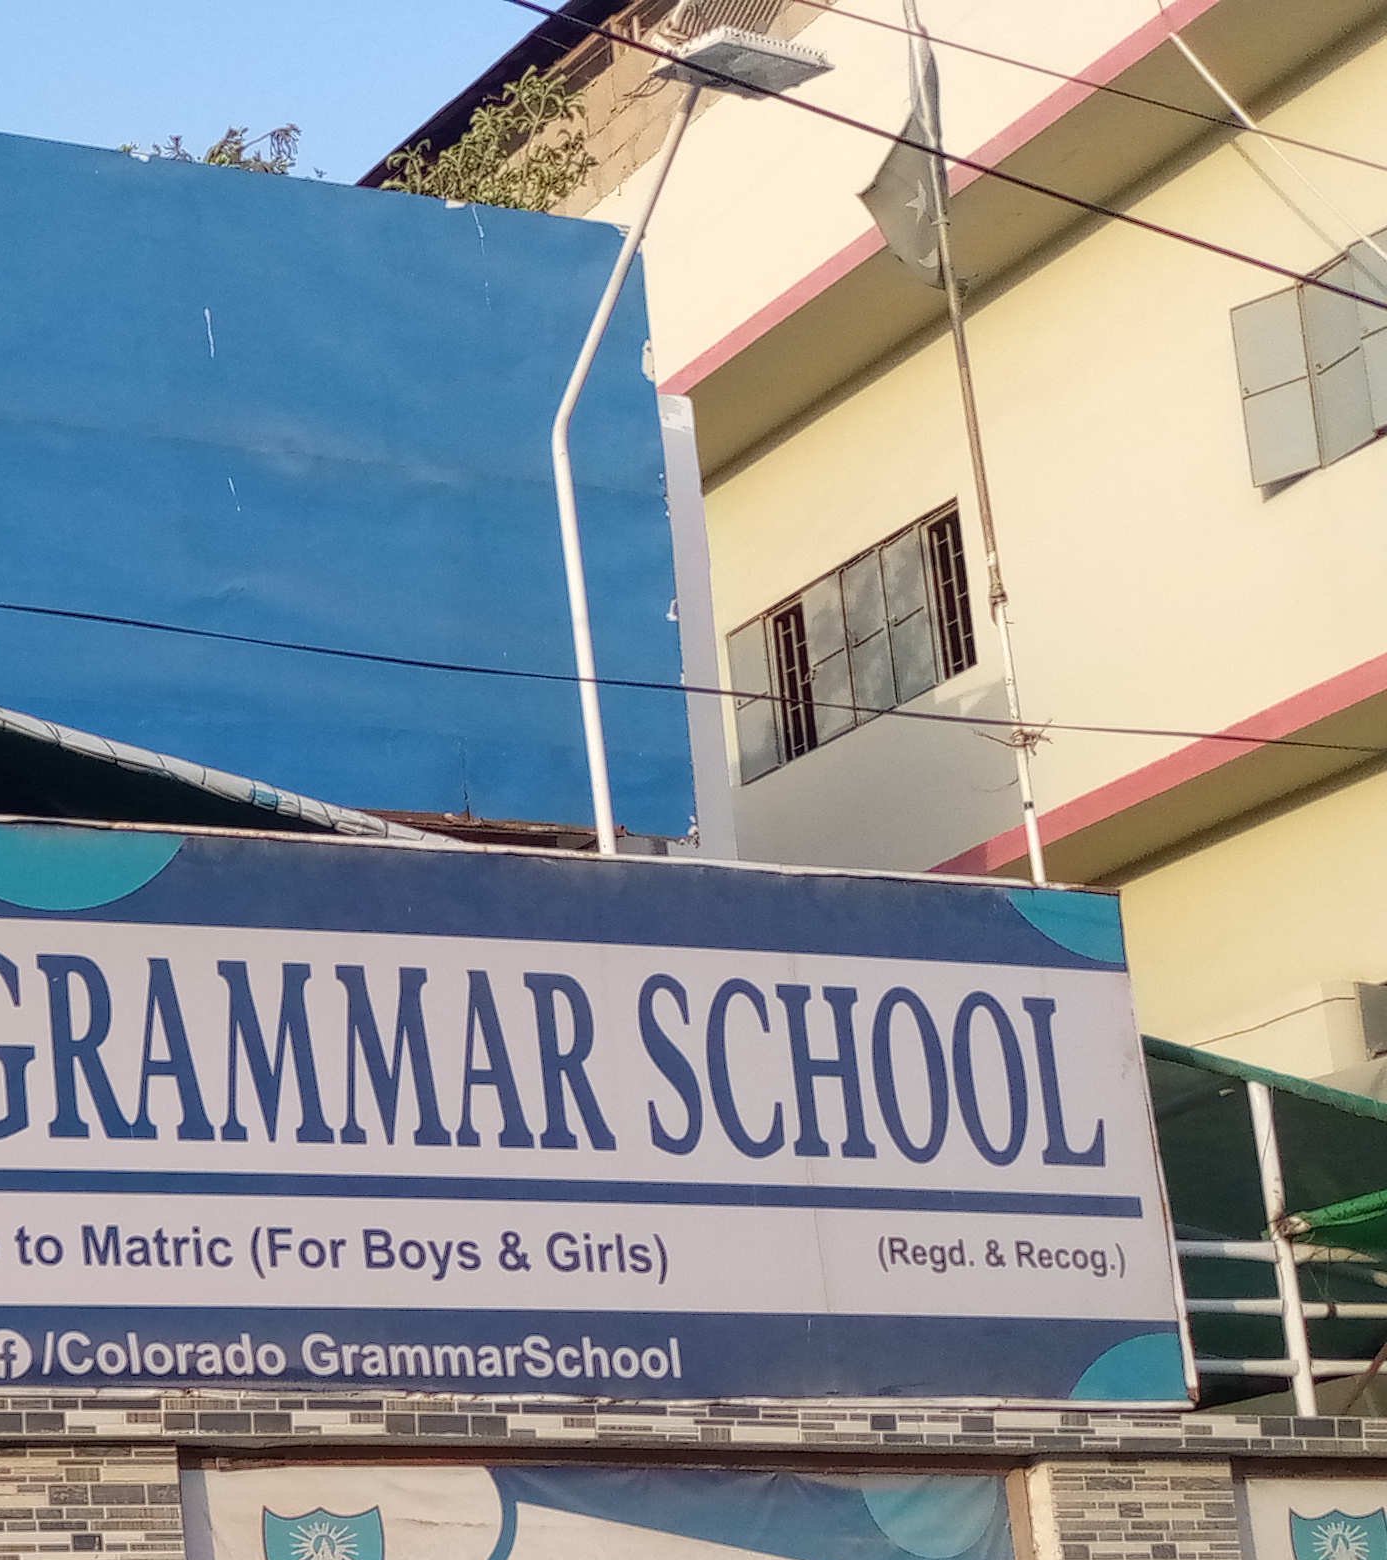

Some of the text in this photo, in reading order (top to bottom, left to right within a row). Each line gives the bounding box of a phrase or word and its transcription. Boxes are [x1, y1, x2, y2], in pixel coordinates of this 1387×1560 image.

[636, 973, 1107, 1168] SCHOOL
[15, 1225, 64, 1266] to
[81, 1223, 233, 1267] Matric
[250, 1226, 346, 1279] (For
[362, 1228, 481, 1281] Boys
[498, 1230, 531, 1272] &
[546, 1231, 668, 1285] Girls)
[878, 1236, 1126, 1279] (Regd. & Recog.)
[41, 1329, 287, 1377] /Colorado
[301, 1331, 683, 1379] GrammarSchool
